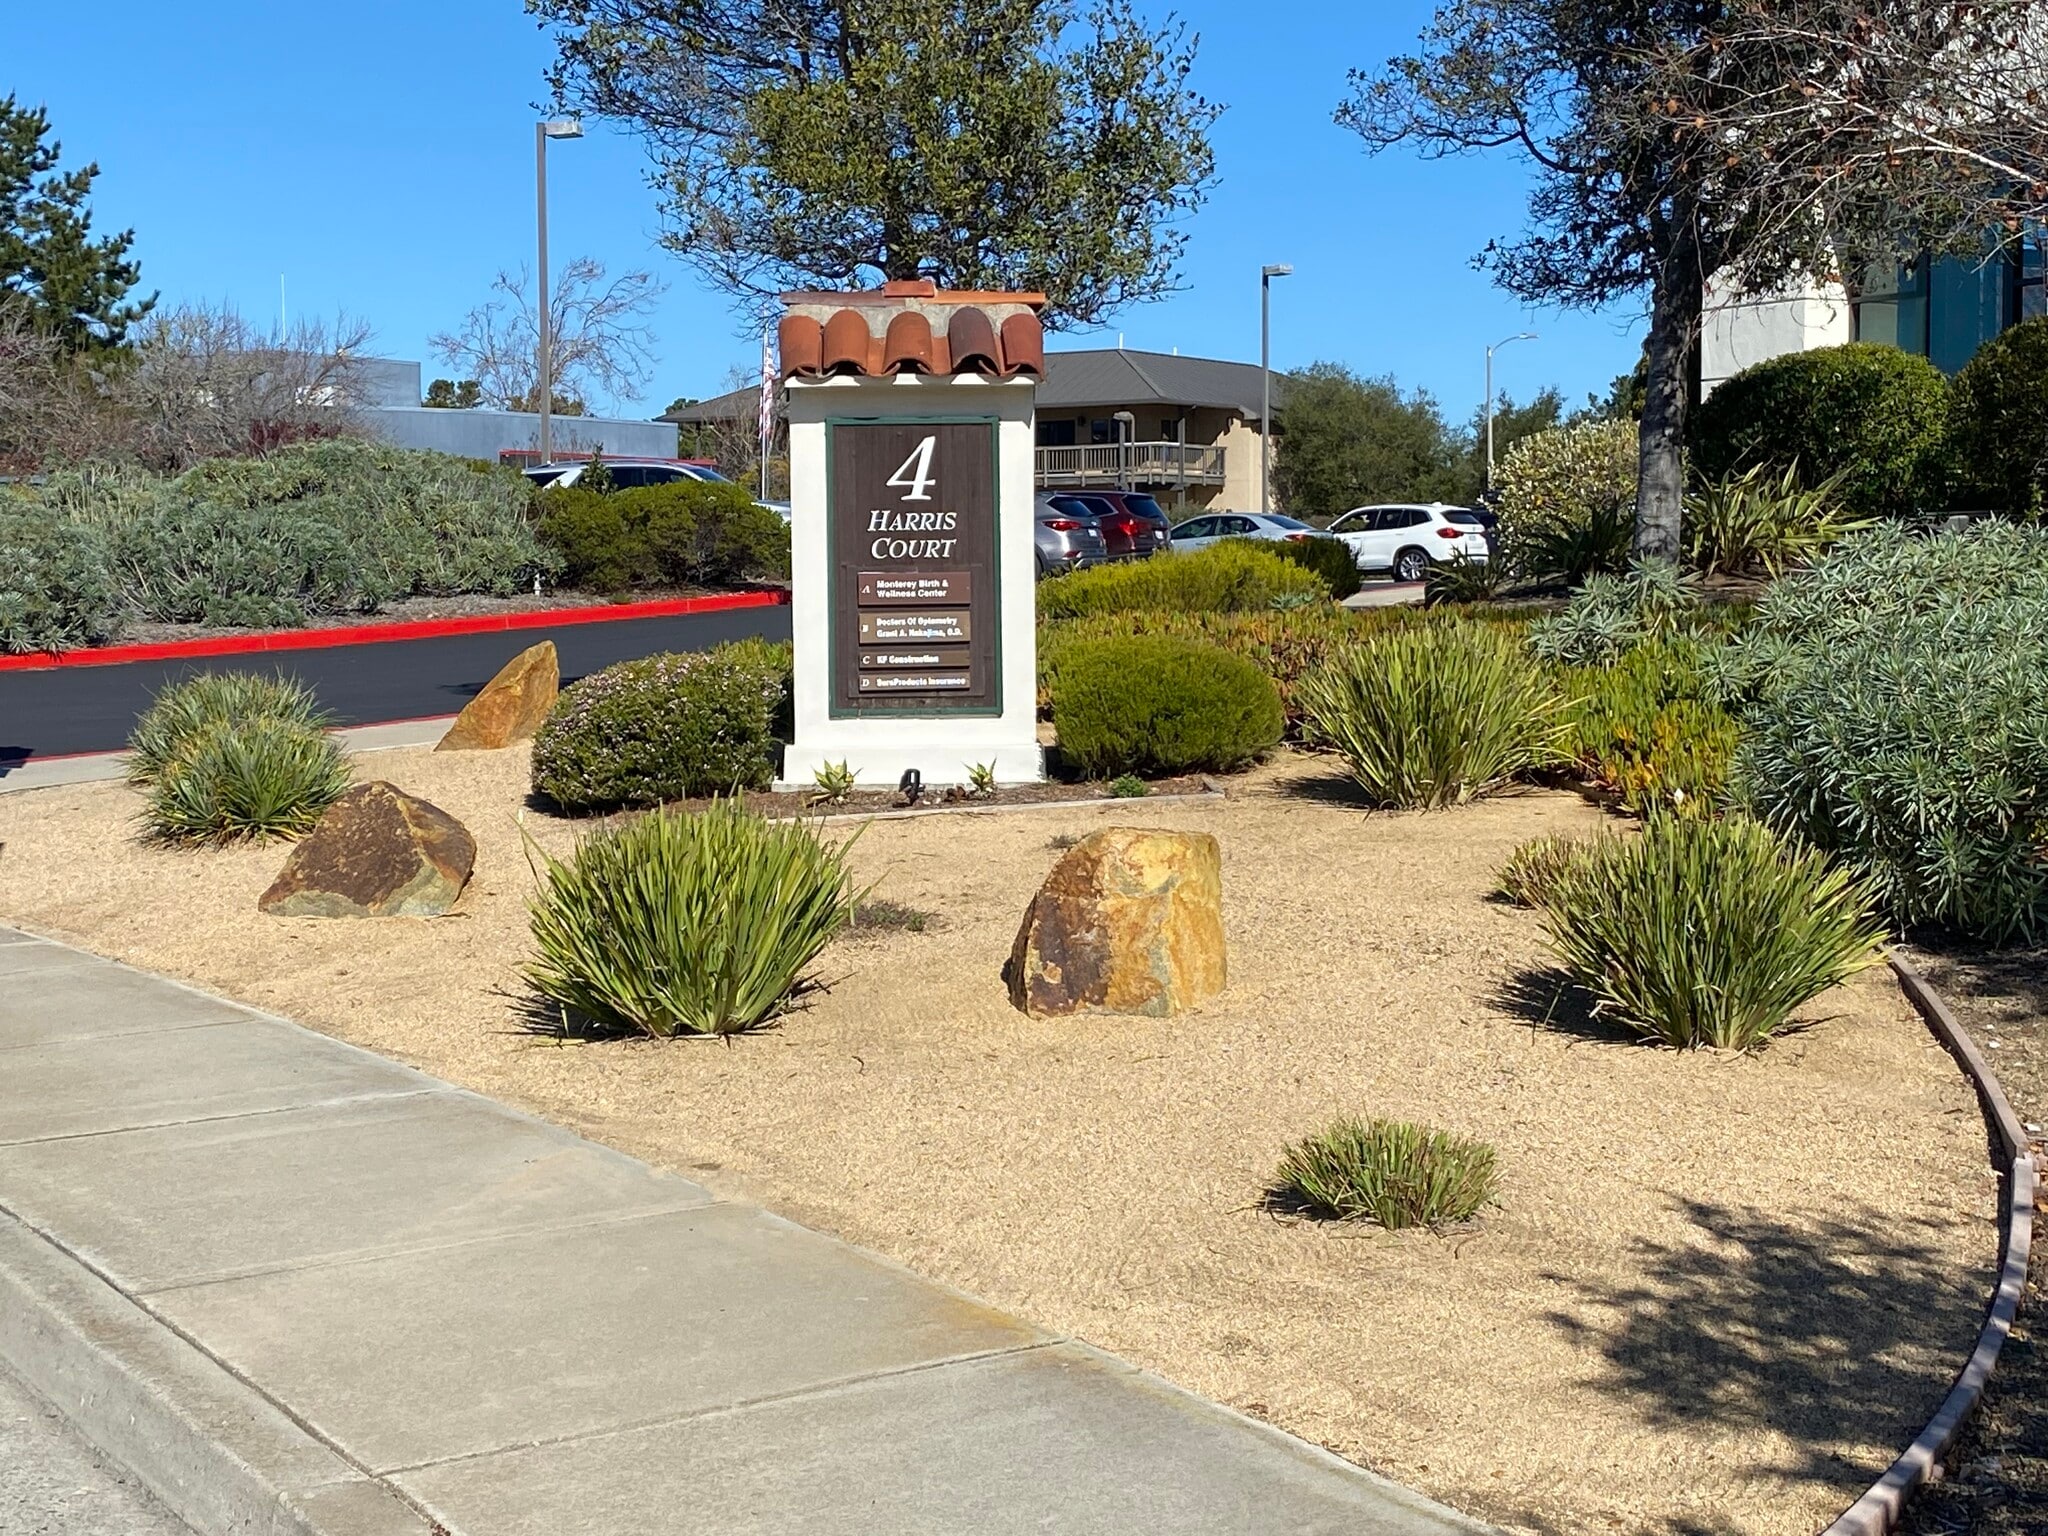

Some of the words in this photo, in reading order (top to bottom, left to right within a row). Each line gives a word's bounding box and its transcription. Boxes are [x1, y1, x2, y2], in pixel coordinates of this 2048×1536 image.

[886, 436, 936, 500] 4
[867, 510, 957, 531] HARRIS
[871, 537, 957, 559] COURT
[877, 580, 917, 589] Monterey
[862, 585, 870, 594] A
[918, 617, 957, 626] Optometry
[862, 656, 870, 664] C
